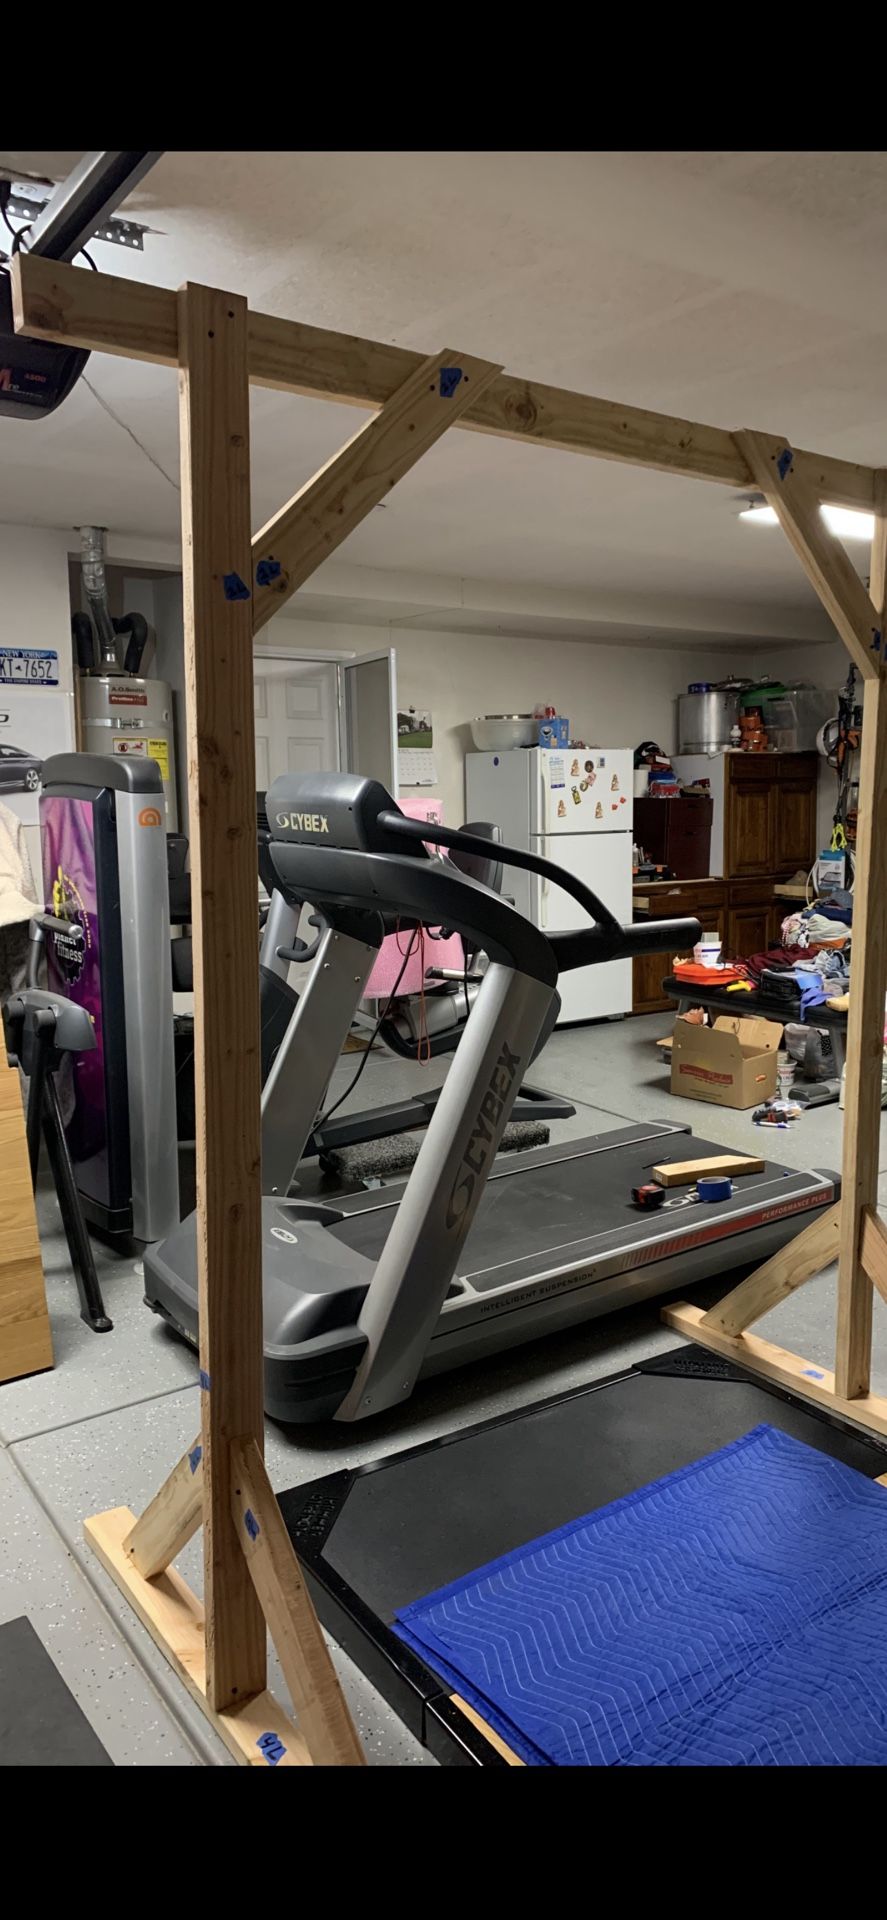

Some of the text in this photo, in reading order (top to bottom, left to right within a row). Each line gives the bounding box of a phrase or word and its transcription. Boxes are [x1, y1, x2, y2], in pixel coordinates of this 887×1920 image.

[23, 659, 52, 679] 7652
[290, 812, 329, 833] CYBEX
[462, 1041, 521, 1176] CYBEX
[762, 1192, 827, 1219] PERFORMANCE PLUS
[480, 1290, 537, 1313] INTELLIGENT
